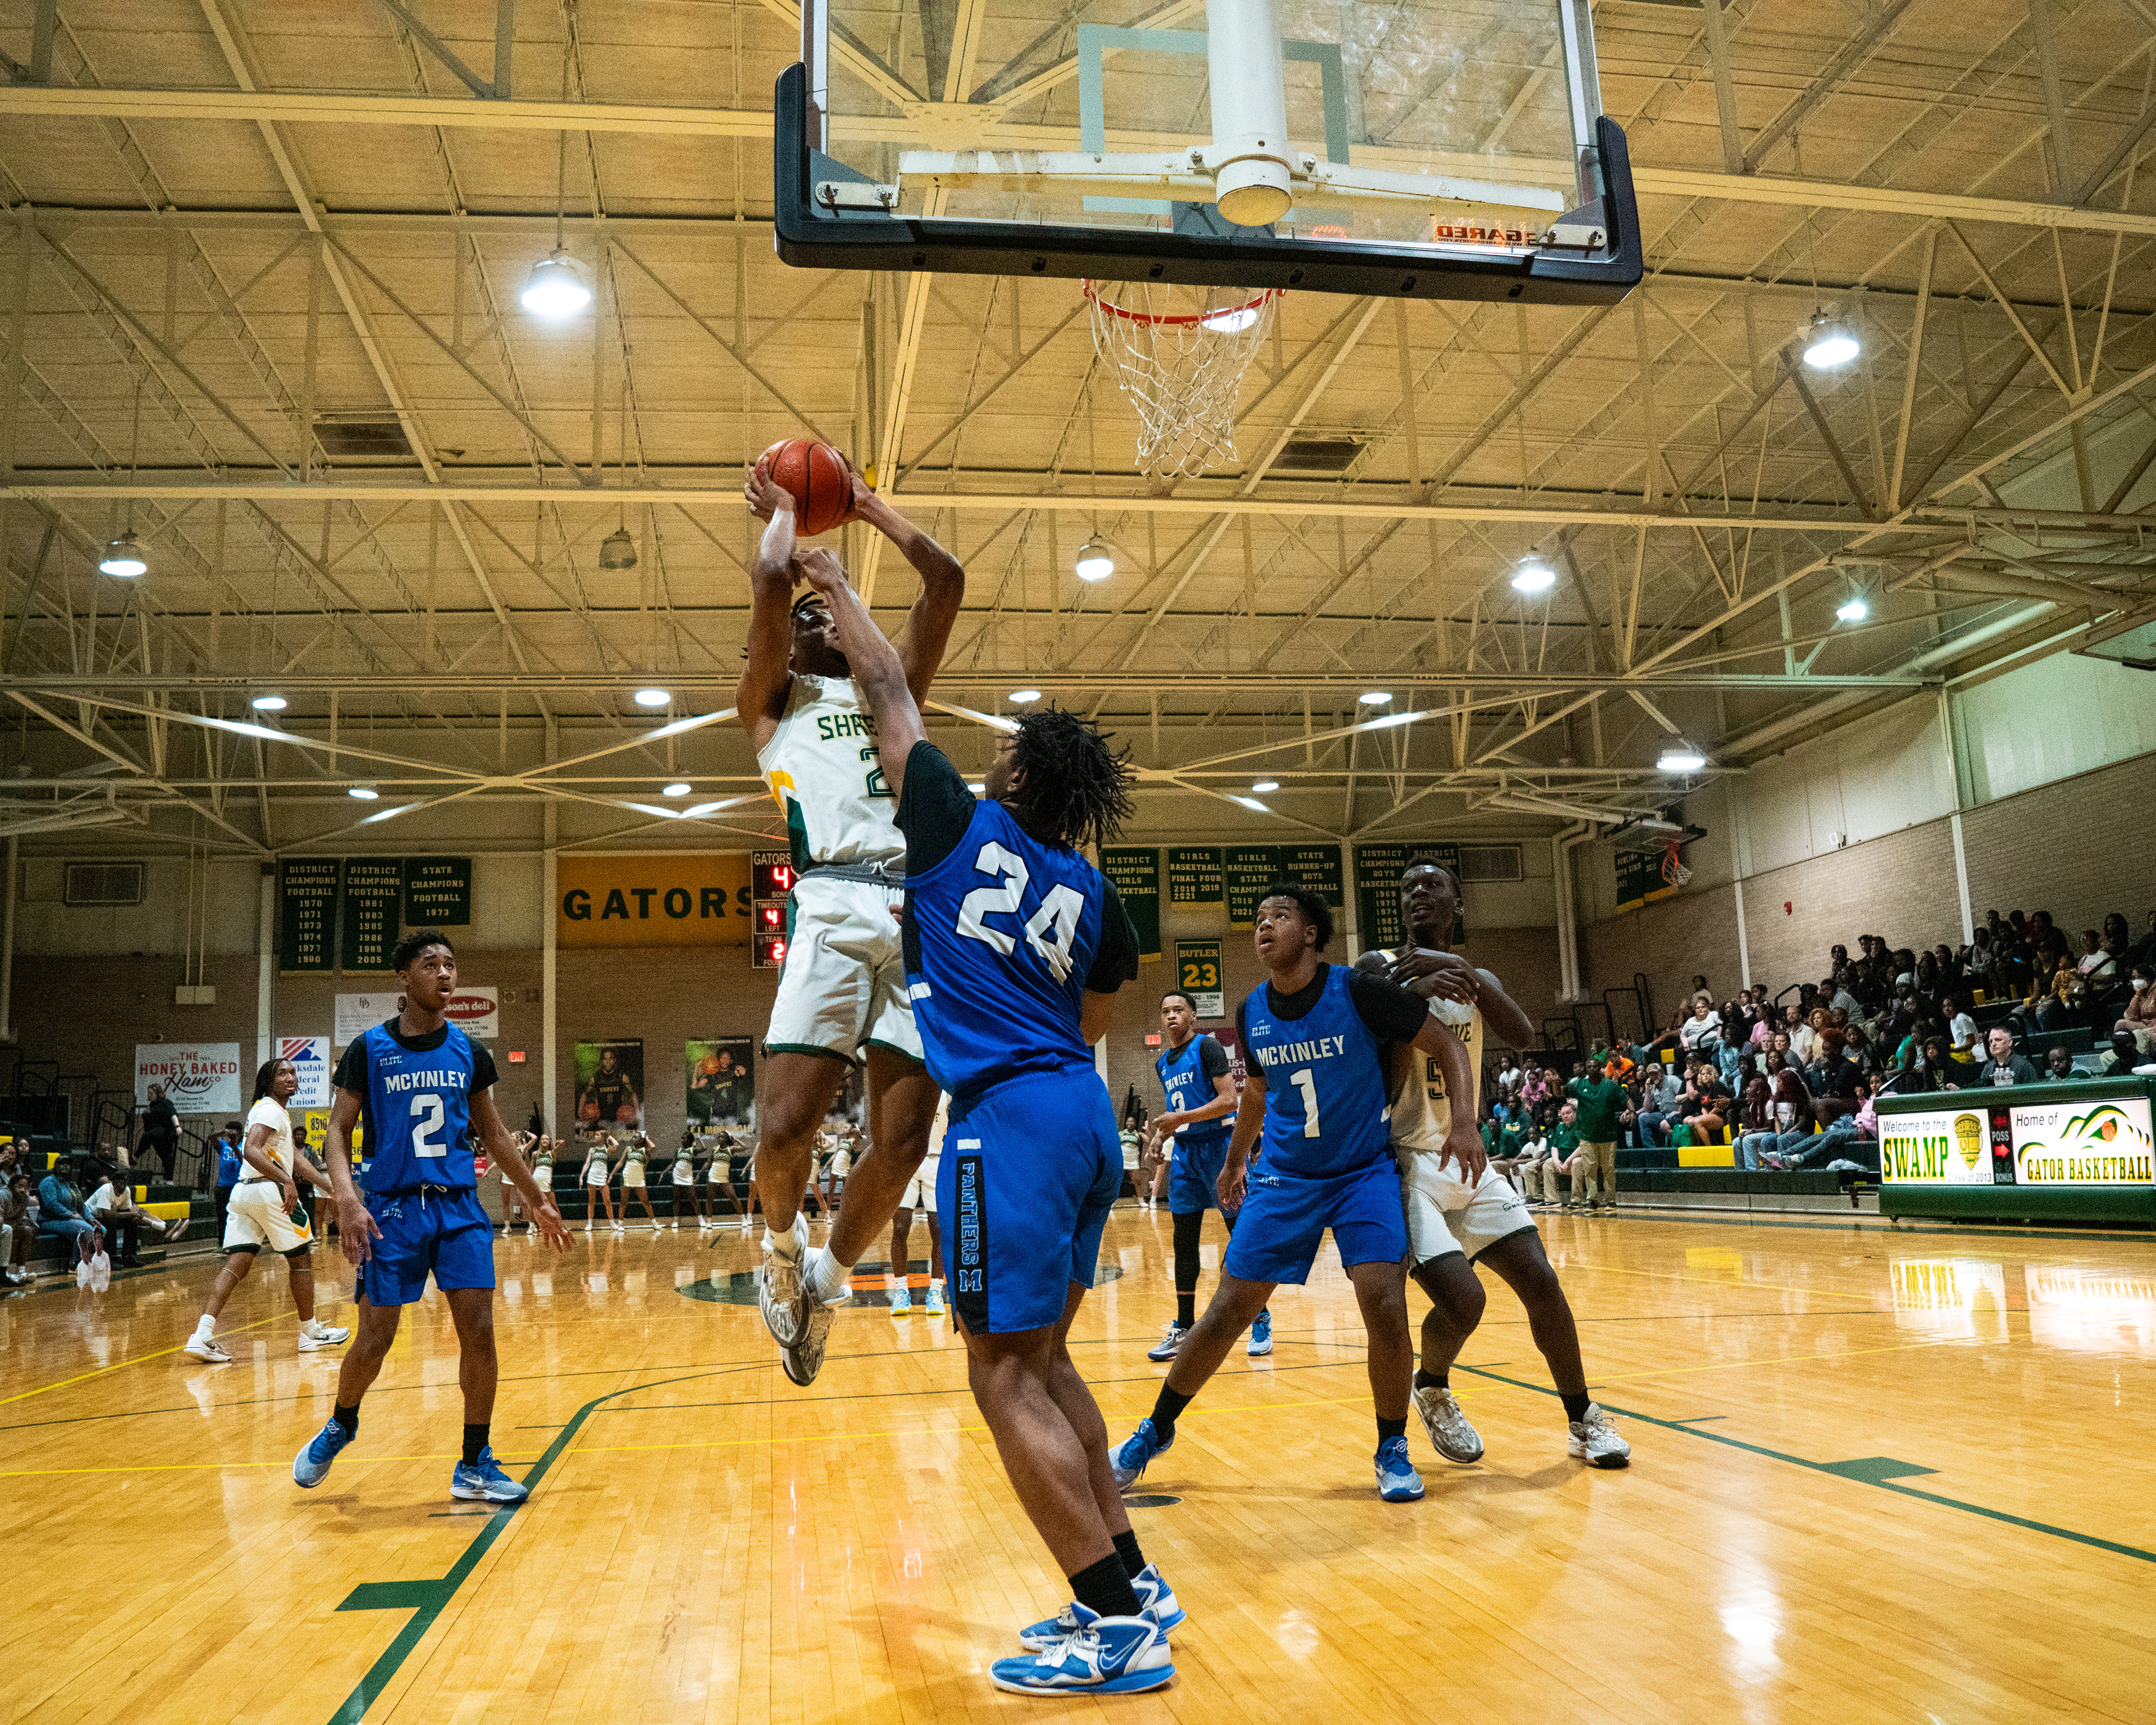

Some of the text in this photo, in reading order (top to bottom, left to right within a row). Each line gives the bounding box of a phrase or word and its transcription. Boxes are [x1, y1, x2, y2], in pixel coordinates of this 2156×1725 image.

[817, 713, 878, 741] SHRE
[753, 853, 791, 865] GATORS
[289, 865, 335, 874] DISTRICT
[351, 866, 397, 875] DISTRICT
[1106, 866, 1154, 874] CHAMPIONS
[1170, 862, 1221, 871] BASKETBALL
[1227, 864, 1277, 872] BASKETBALL
[1288, 862, 1335, 871] RUNNER-UP
[286, 877, 336, 885] CHAMPIONS
[412, 880, 464, 888] CHAMPIONS
[1117, 887, 1157, 895] SKETBALL
[1296, 883, 1338, 892] SKETBALL
[563, 887, 752, 920] GATORS
[766, 910, 778, 924] 4
[956, 840, 1084, 986] 24
[773, 943, 784, 959] 2
[1179, 949, 1218, 957] BUTLER
[1183, 964, 1217, 987] 23
[444, 1001, 490, 1011] son's deli
[1252, 1025, 1271, 1037] ELITE
[1147, 1034, 1161, 1045] EXIT
[1257, 1034, 1344, 1066] MCKINLEY
[180, 1052, 198, 1061] THE
[510, 1052, 525, 1062] EXIT
[140, 1062, 237, 1075] HONEY BAKED
[165, 1071, 213, 1094] Ham
[384, 1070, 465, 1094] MCKINLEY
[715, 1081, 732, 1089] SHREVE
[1290, 1067, 1320, 1138] 1
[410, 1093, 446, 1158] 2
[2017, 1112, 2058, 1127] Home of
[1883, 1119, 1947, 1133] Welcome to the
[1991, 1130, 2009, 1142] POSS
[1883, 1135, 1949, 1182] SWAMP
[2027, 1156, 2152, 1182] GATOR BASKETBALL
[1948, 1172, 1992, 1183] Class of 2013
[1995, 1172, 2013, 1183] BONUS
[961, 1162, 979, 1265] PANTHERS
[959, 1269, 982, 1292] M
